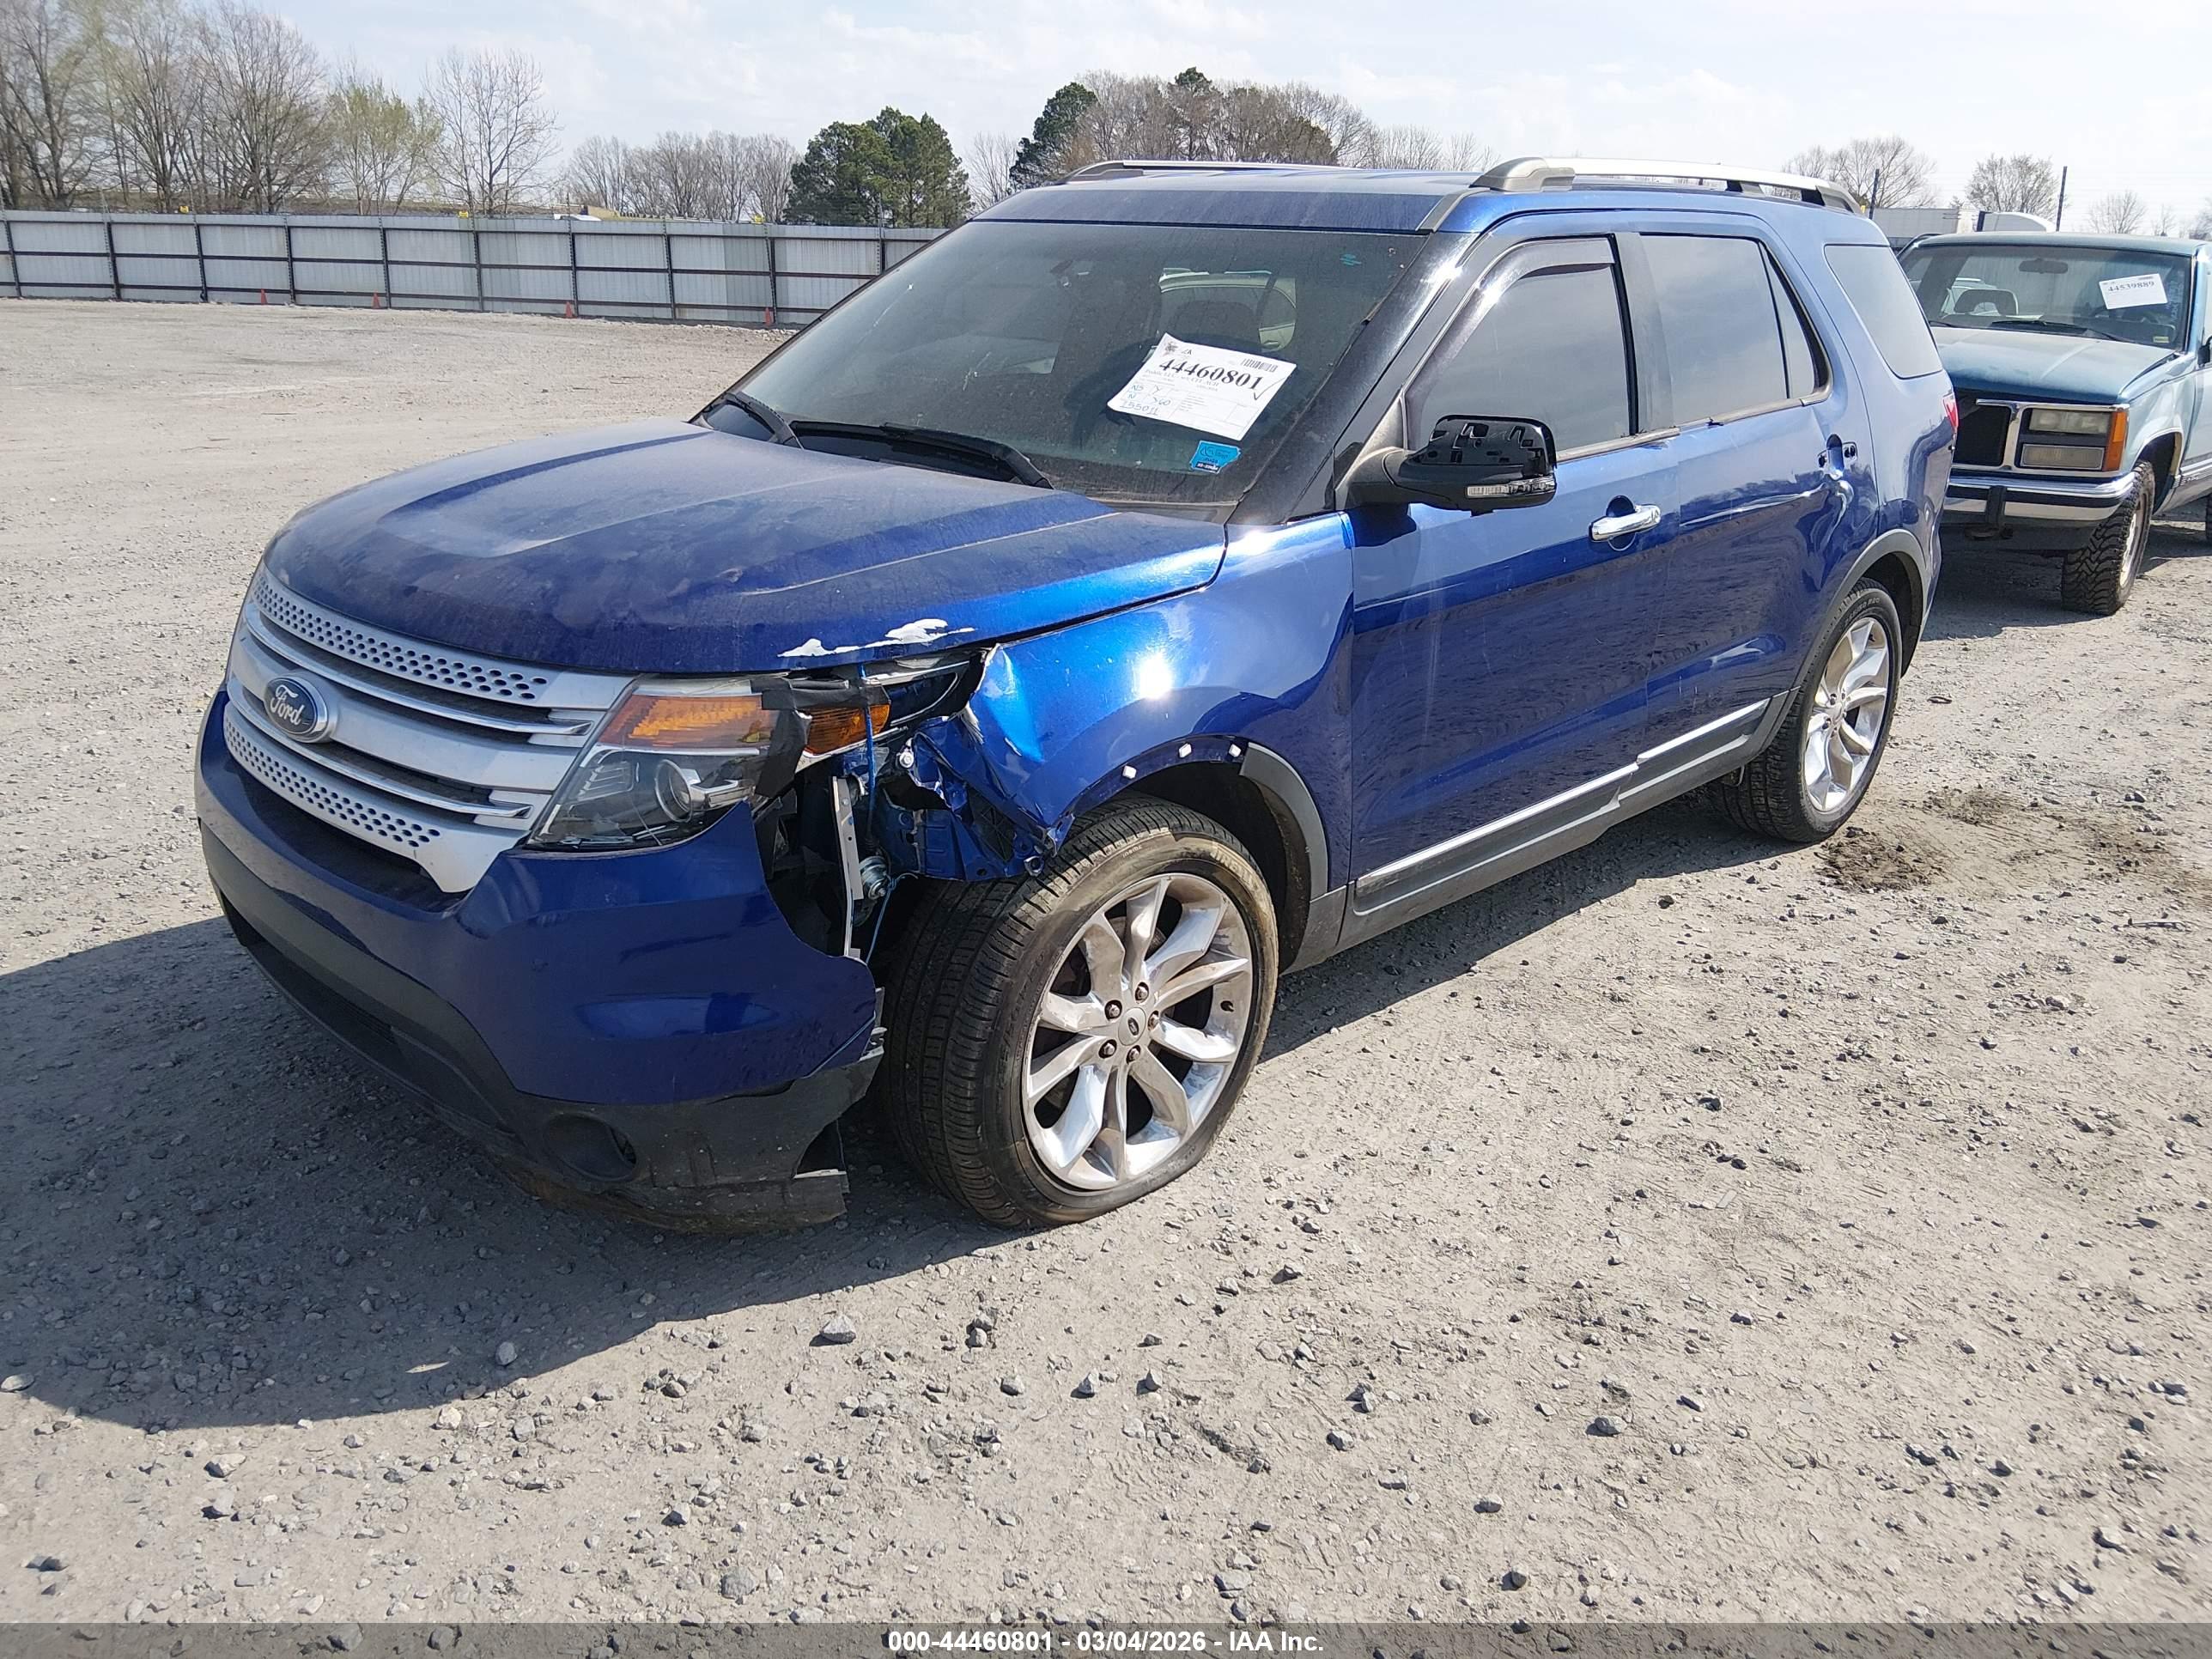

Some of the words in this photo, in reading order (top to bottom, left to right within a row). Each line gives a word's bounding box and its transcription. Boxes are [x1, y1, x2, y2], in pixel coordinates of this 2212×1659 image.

[2108, 281, 2154, 292] 44539889
[1158, 358, 1264, 391] 44460801
[270, 684, 306, 726] Ford
